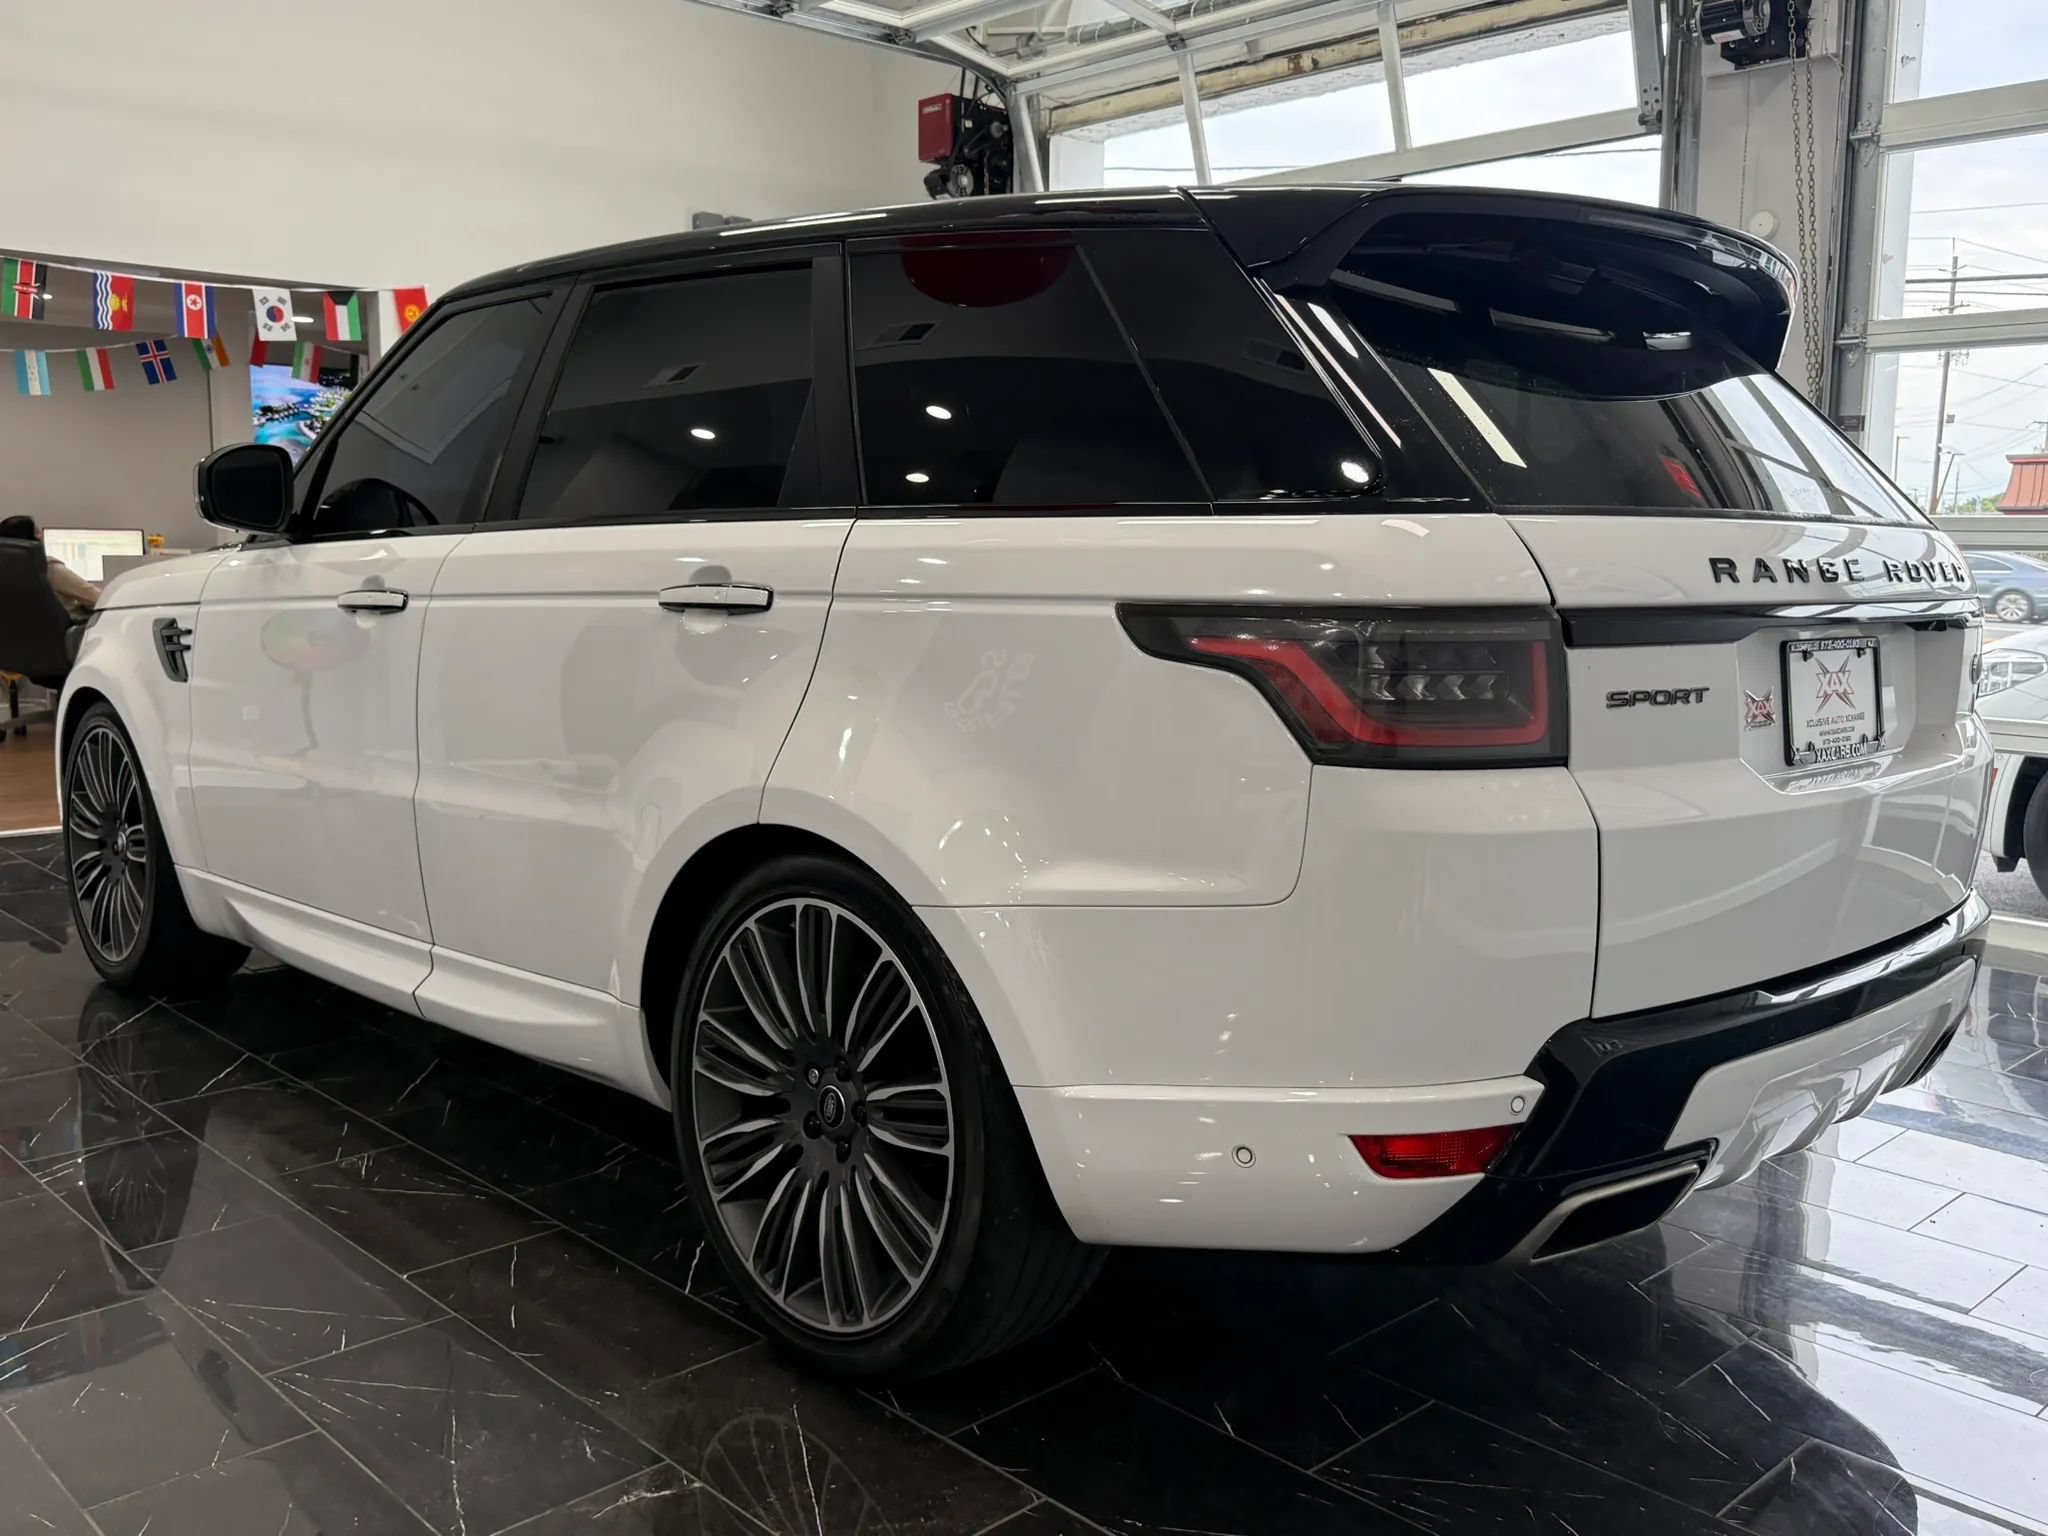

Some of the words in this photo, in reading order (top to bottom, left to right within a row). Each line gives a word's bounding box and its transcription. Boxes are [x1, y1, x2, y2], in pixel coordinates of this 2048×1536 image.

[1708, 557, 1865, 584] RANGE
[1882, 558, 1966, 583] ROVER
[1815, 670, 1855, 699] XAX
[1606, 687, 1710, 709] SPORT
[1806, 716, 1830, 728] XCLUSIVE
[1830, 714, 1845, 725] AUTO
[1845, 711, 1865, 723] XCHANGE
[1815, 743, 1867, 763] XAXCARS.COM
